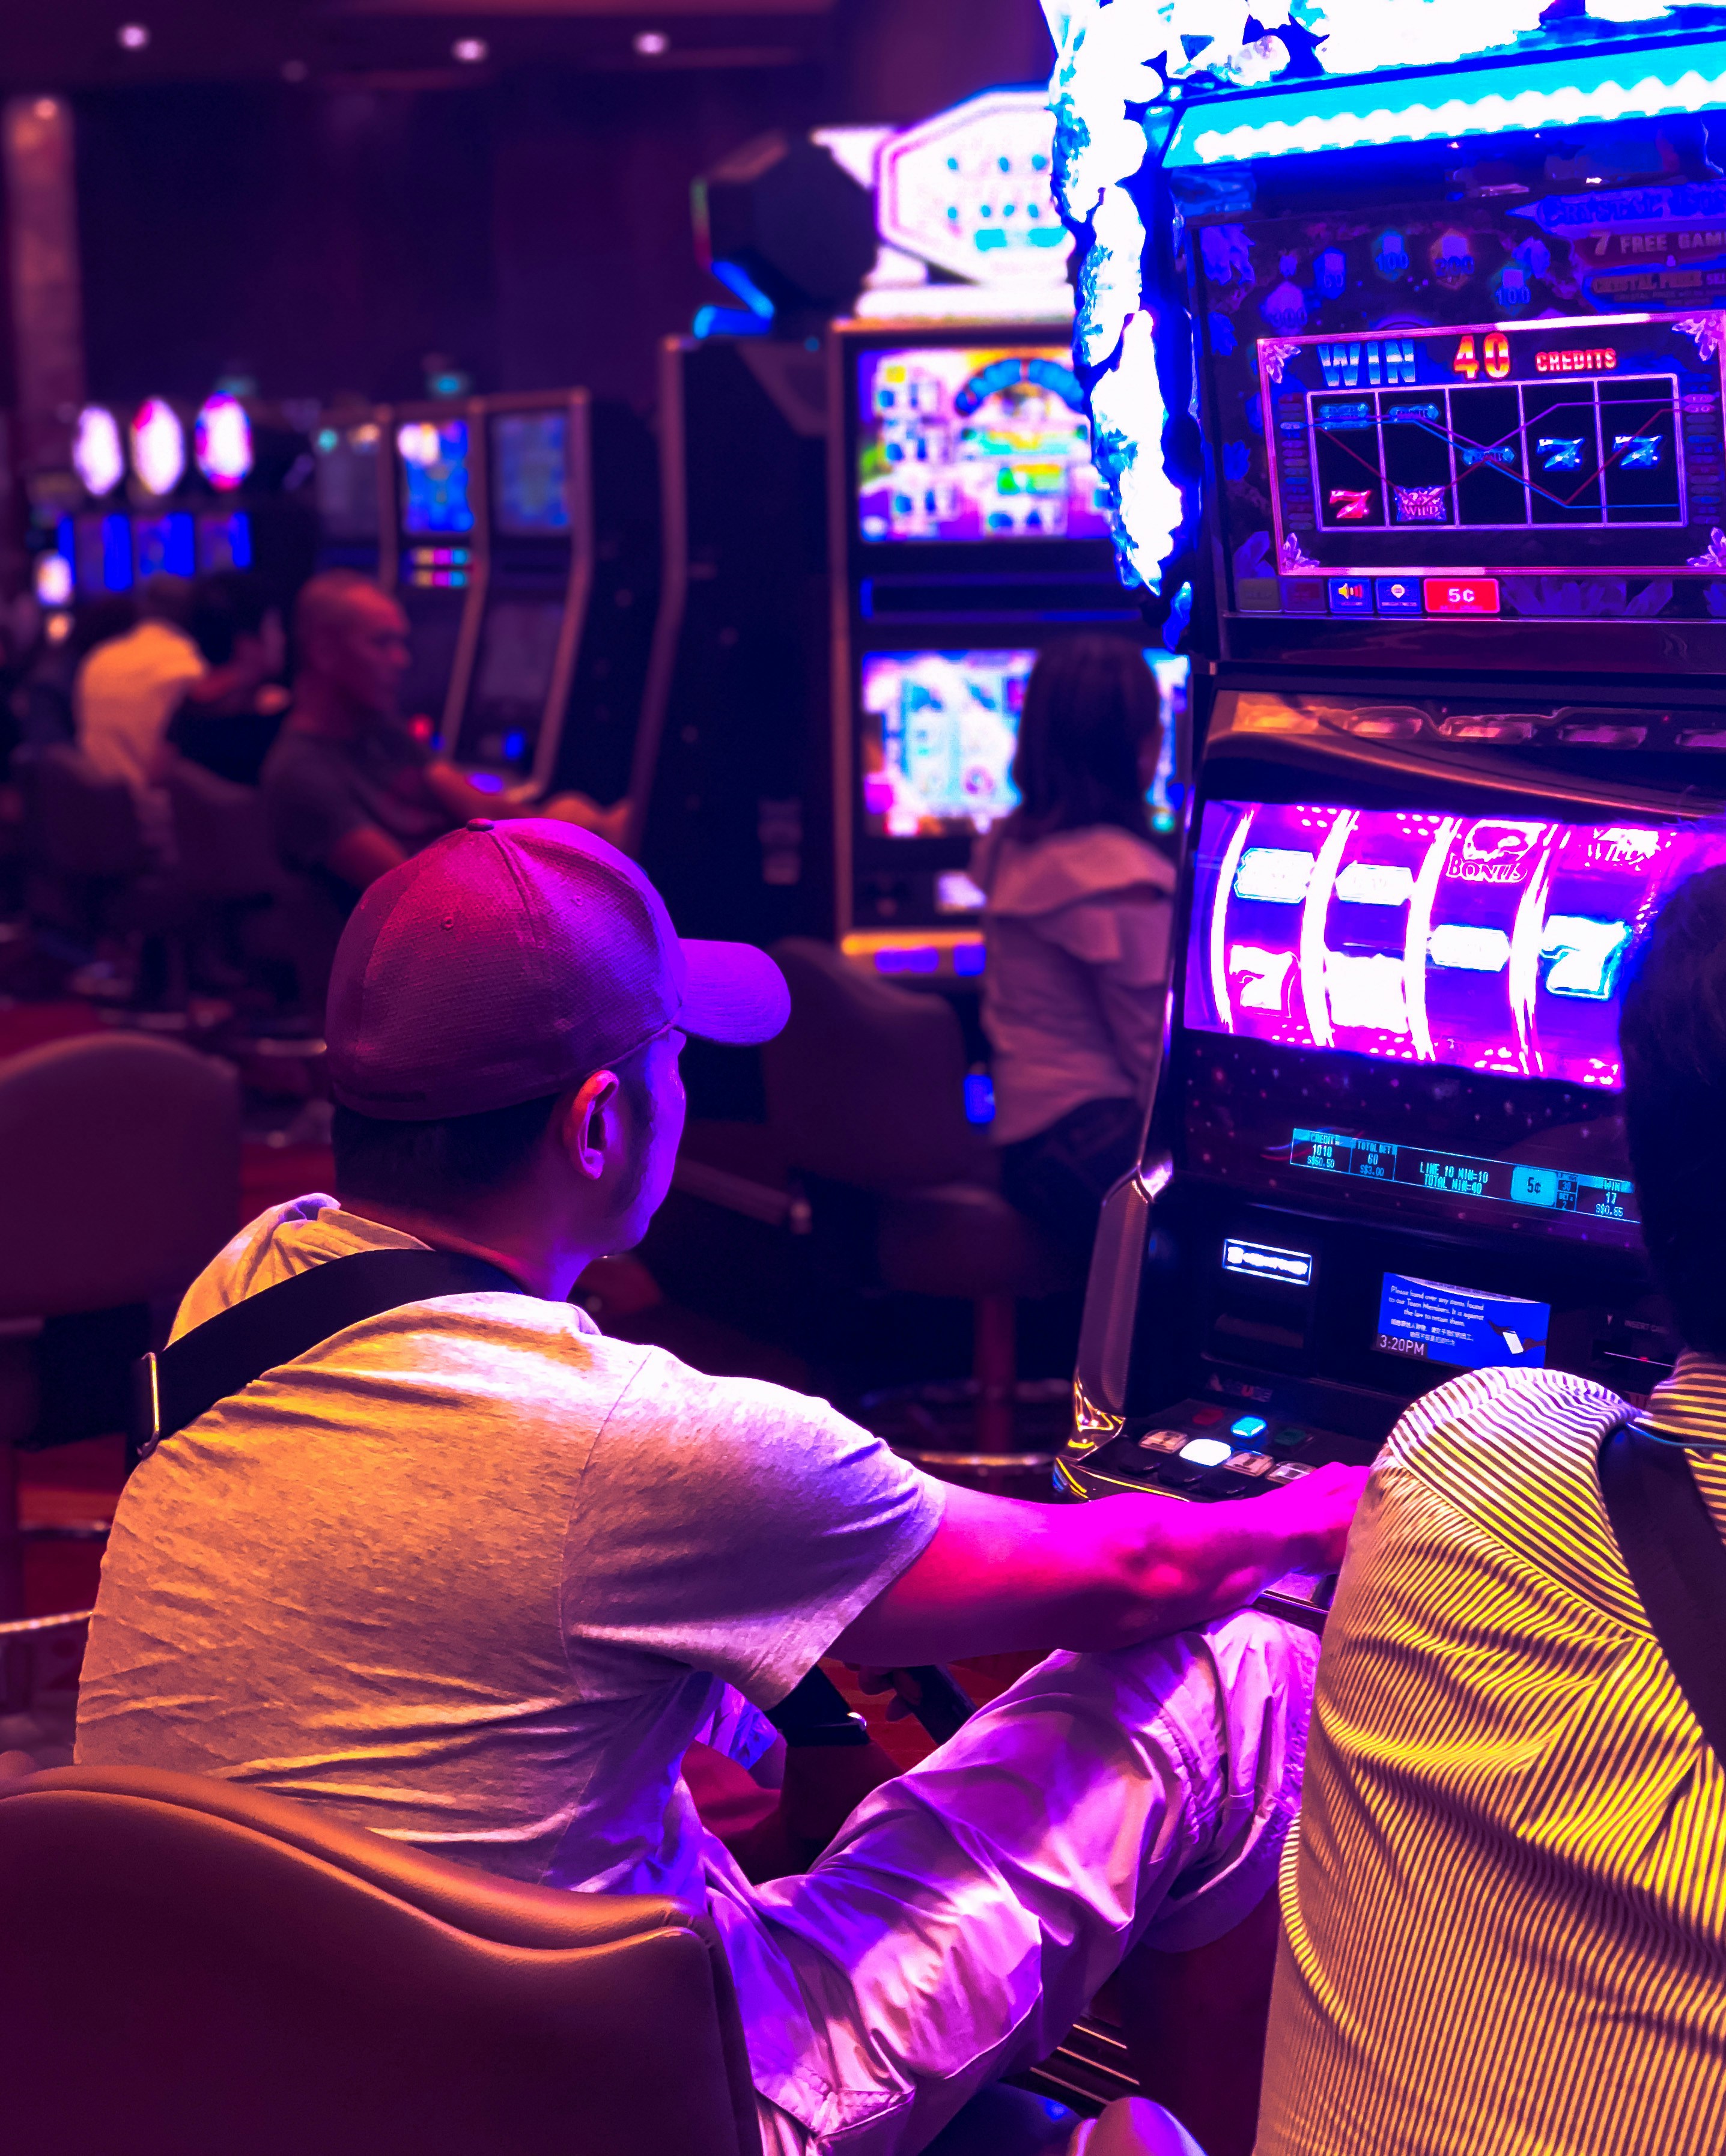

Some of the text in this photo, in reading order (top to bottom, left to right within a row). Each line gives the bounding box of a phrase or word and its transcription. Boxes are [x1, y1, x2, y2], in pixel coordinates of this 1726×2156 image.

[1590, 231, 1726, 256] 7 FREE GAM
[1375, 252, 1410, 272] 100
[1494, 284, 1531, 306] 100
[1317, 333, 1617, 387] WIN 40 CREDITS
[1445, 852, 1529, 884] BONUS
[1313, 1144, 1332, 1158] 1010
[1420, 1161, 1441, 1176] LINE
[1424, 1174, 1447, 1189] TOTAL
[1527, 1176, 1542, 1194] 5¢
[1603, 1180, 1621, 1191] WIN
[1605, 1192, 1617, 1204] 17
[1391, 1285, 1409, 1296] Please
[1379, 1334, 1425, 1356] 3:20PM
